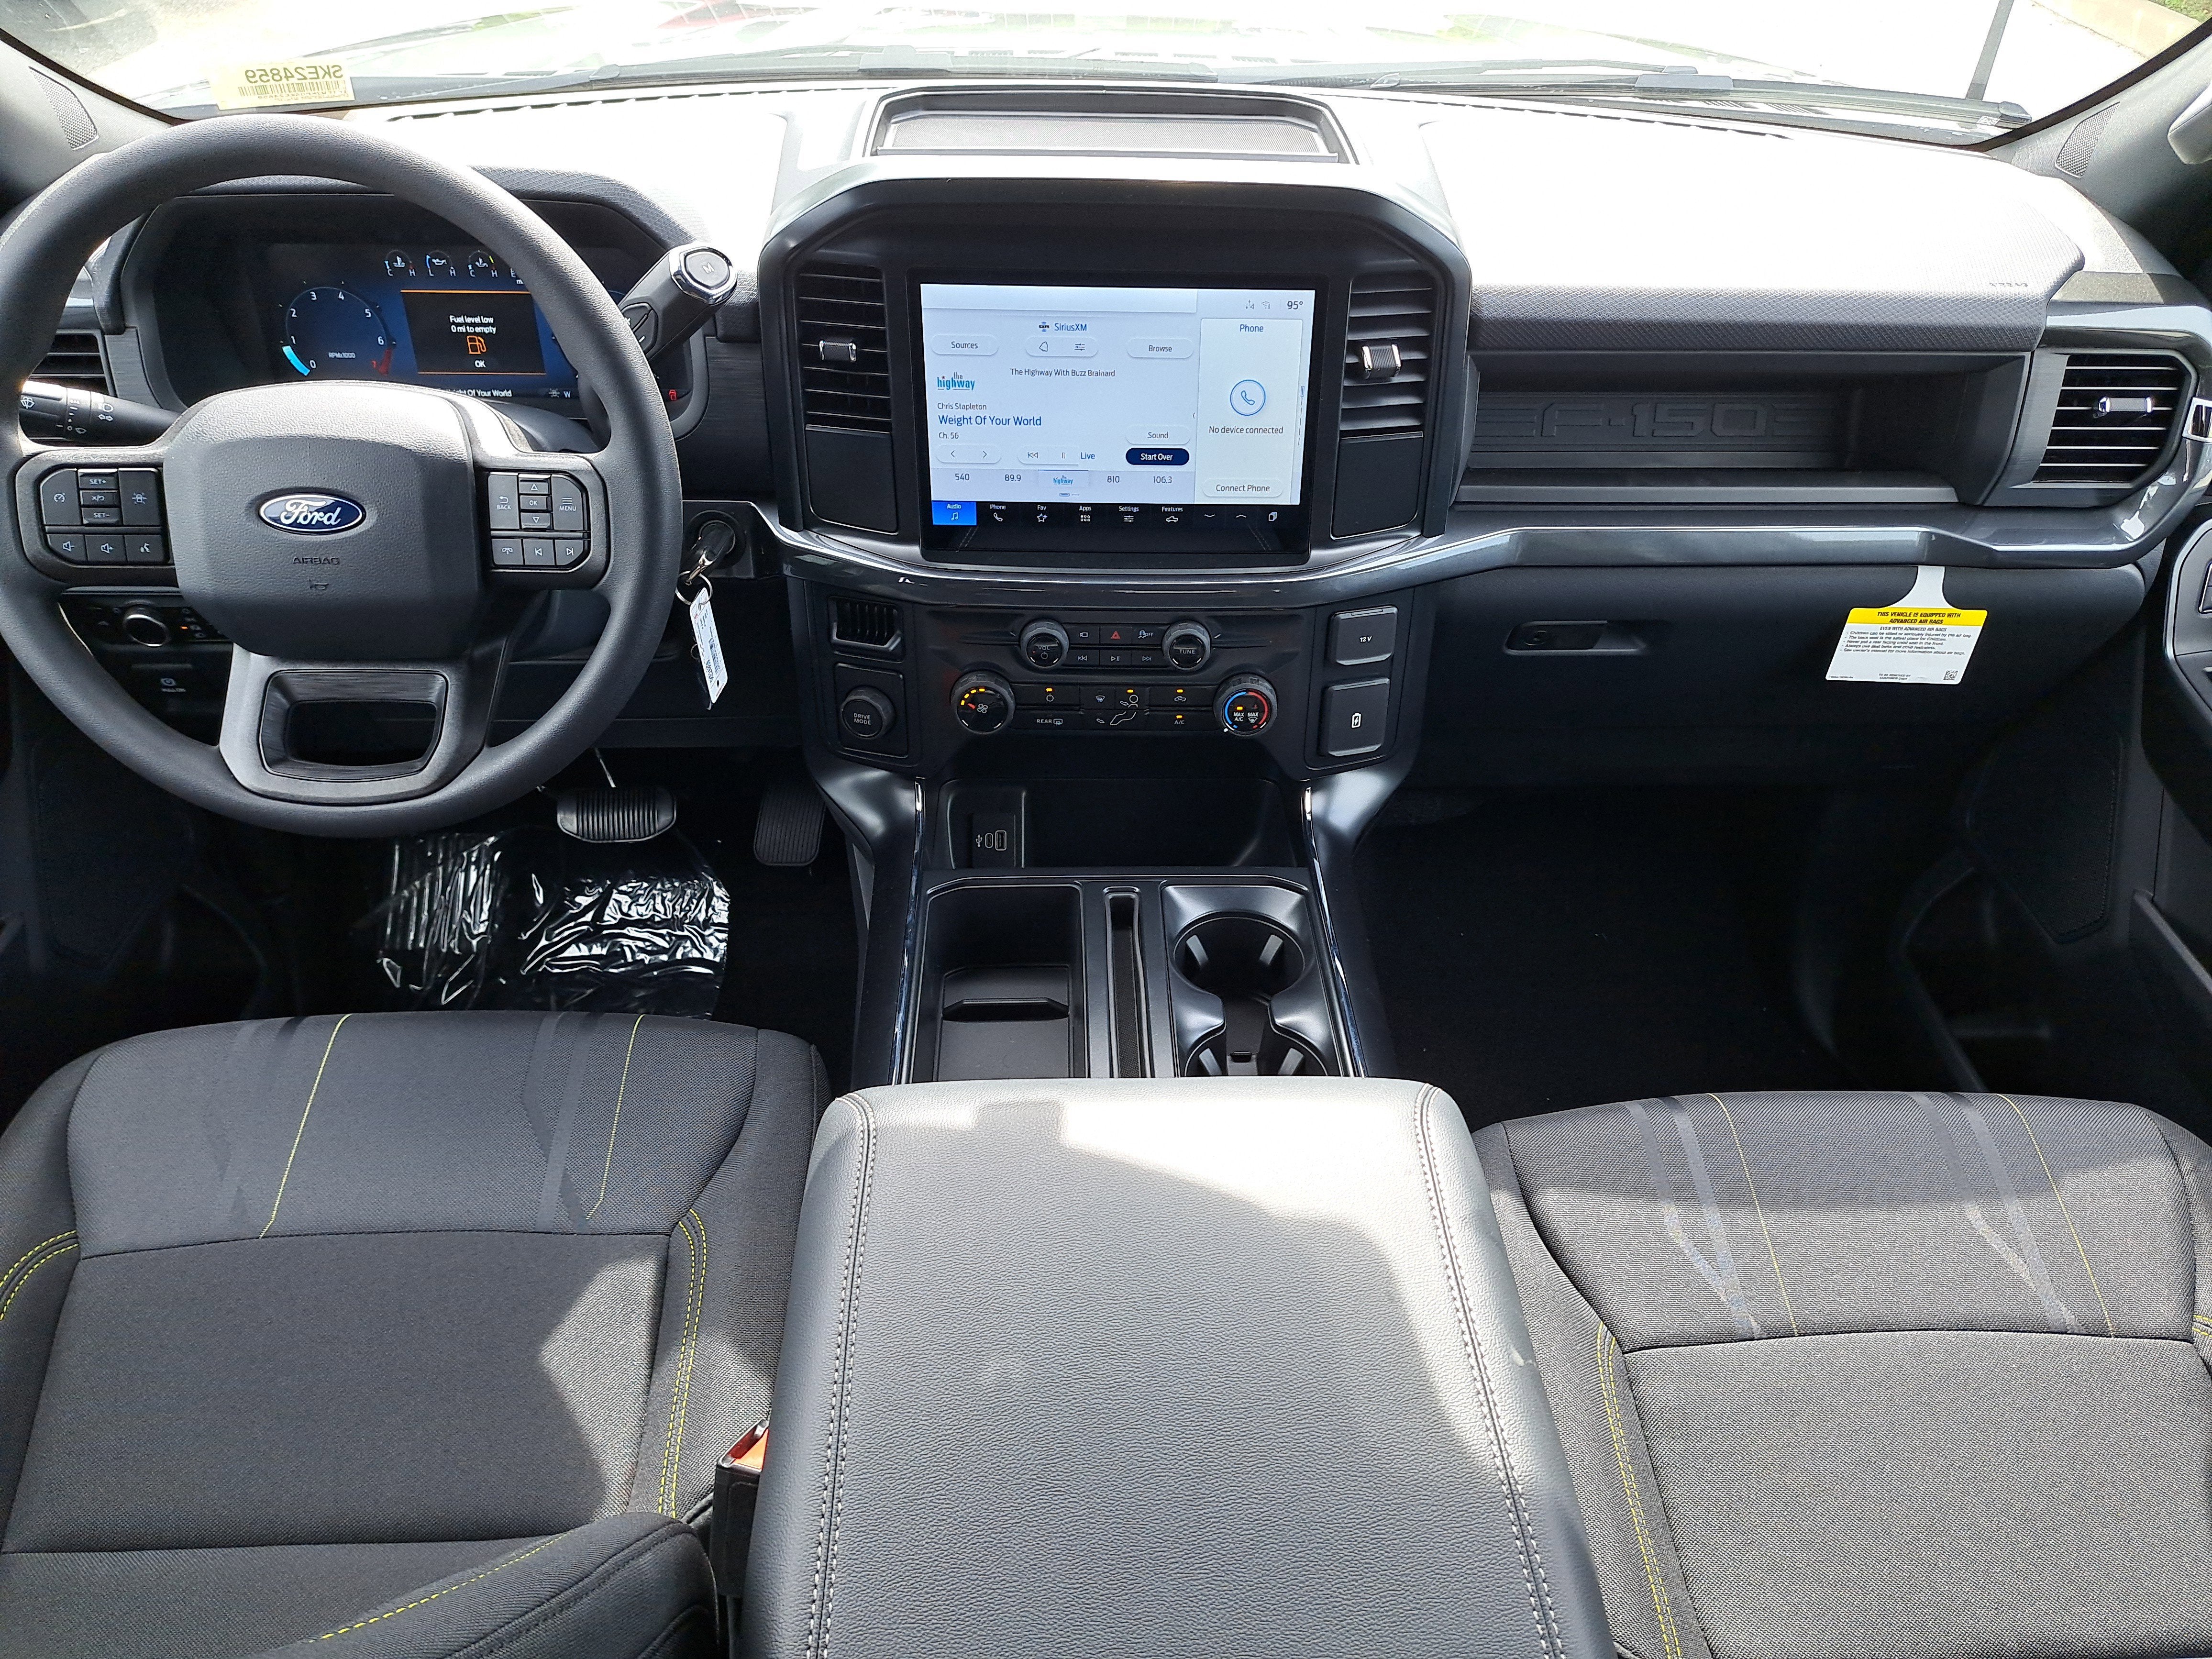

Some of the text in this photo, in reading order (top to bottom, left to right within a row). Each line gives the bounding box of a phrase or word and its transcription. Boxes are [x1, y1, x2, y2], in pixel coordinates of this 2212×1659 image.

[702, 262, 714, 274] M
[310, 291, 317, 300] 3
[338, 291, 344, 300] 4
[1287, 300, 1303, 310] 95°
[290, 308, 298, 317] 2
[365, 309, 371, 318] 5
[450, 315, 465, 323] Fuel
[465, 315, 481, 323] level
[1054, 323, 1087, 332] SiriusXM
[1239, 324, 1264, 332] Phone
[290, 335, 296, 344] 1
[377, 336, 384, 345] 6
[951, 341, 978, 350] Sources
[310, 360, 316, 368] 0
[475, 360, 487, 368] OK
[1024, 369, 1052, 377] Highway
[937, 376, 975, 389] highway
[492, 389, 512, 397] World
[954, 403, 987, 411] Stapleton
[938, 414, 1042, 427] Weight Of Your World
[1541, 403, 1769, 437] F-150
[1209, 426, 1219, 434] No
[1221, 426, 1244, 434] device
[1081, 452, 1095, 460] Live
[1216, 484, 1245, 492] Connect
[279, 498, 342, 525] Ford
[292, 556, 341, 565] AIRBAG
